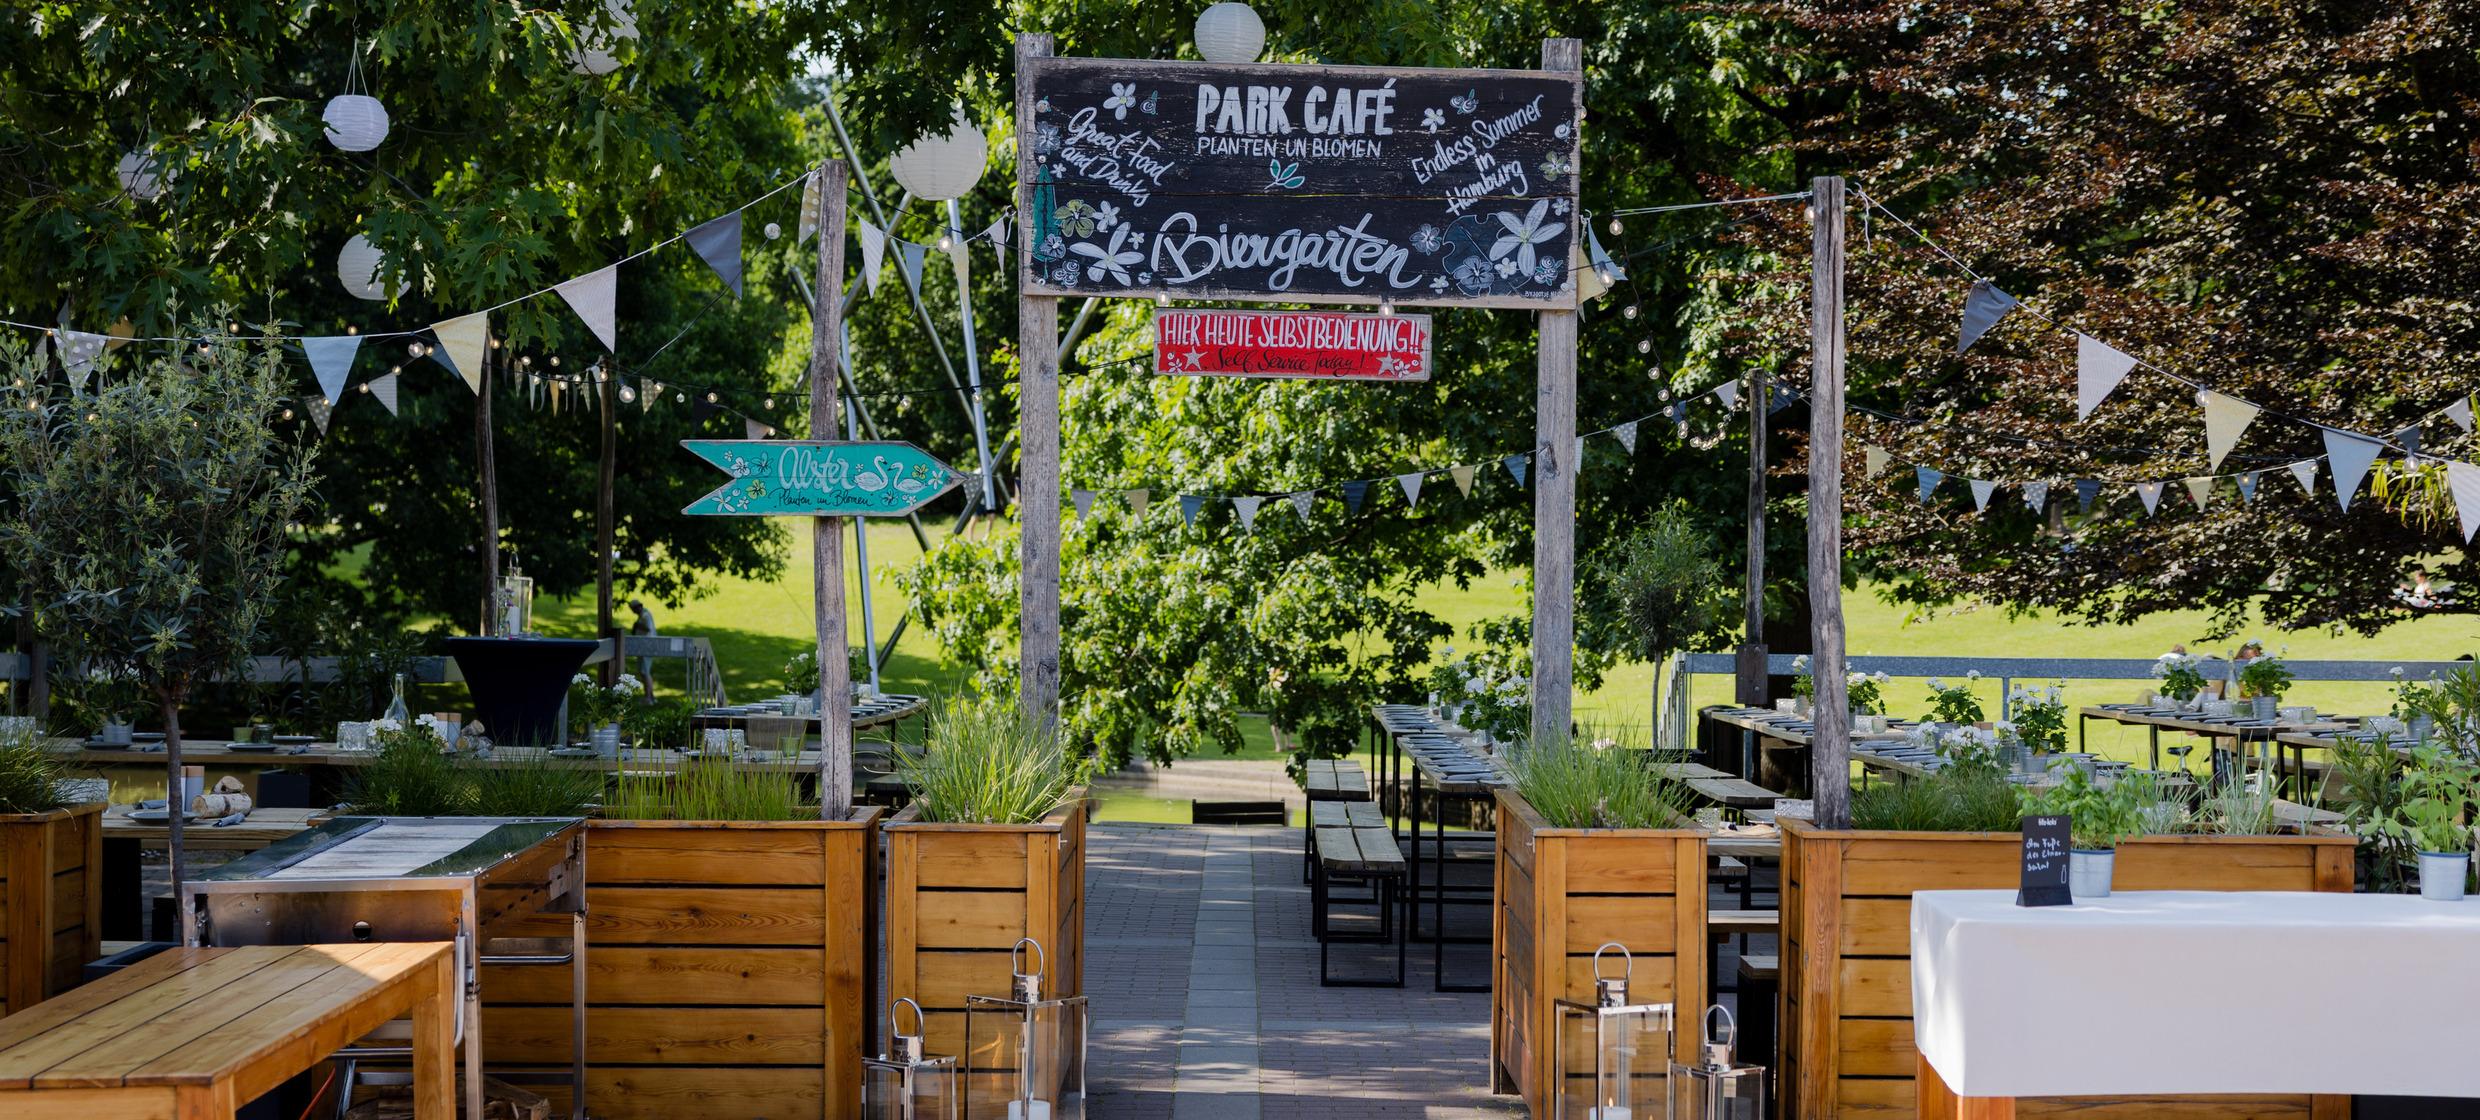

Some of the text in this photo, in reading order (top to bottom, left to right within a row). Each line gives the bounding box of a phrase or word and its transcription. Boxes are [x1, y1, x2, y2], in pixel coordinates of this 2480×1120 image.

[1195, 77, 1397, 136] PARK CAFÉ
[1065, 106, 1175, 187] Great Food
[1197, 136, 1382, 159] PLANTEN UN BLOMEN
[1411, 94, 1544, 184] Endless Summer
[1473, 152, 1496, 172] in
[1061, 146, 1151, 208] and Drinks
[1445, 160, 1528, 216] Hamburg
[1150, 212, 1422, 291] Biergarten
[1164, 313, 1422, 355] HIER HEUTE SELBSTBEDIENUNG!!
[1212, 347, 1255, 374] Self
[1256, 350, 1310, 372] Service
[778, 446, 856, 494] Alster
